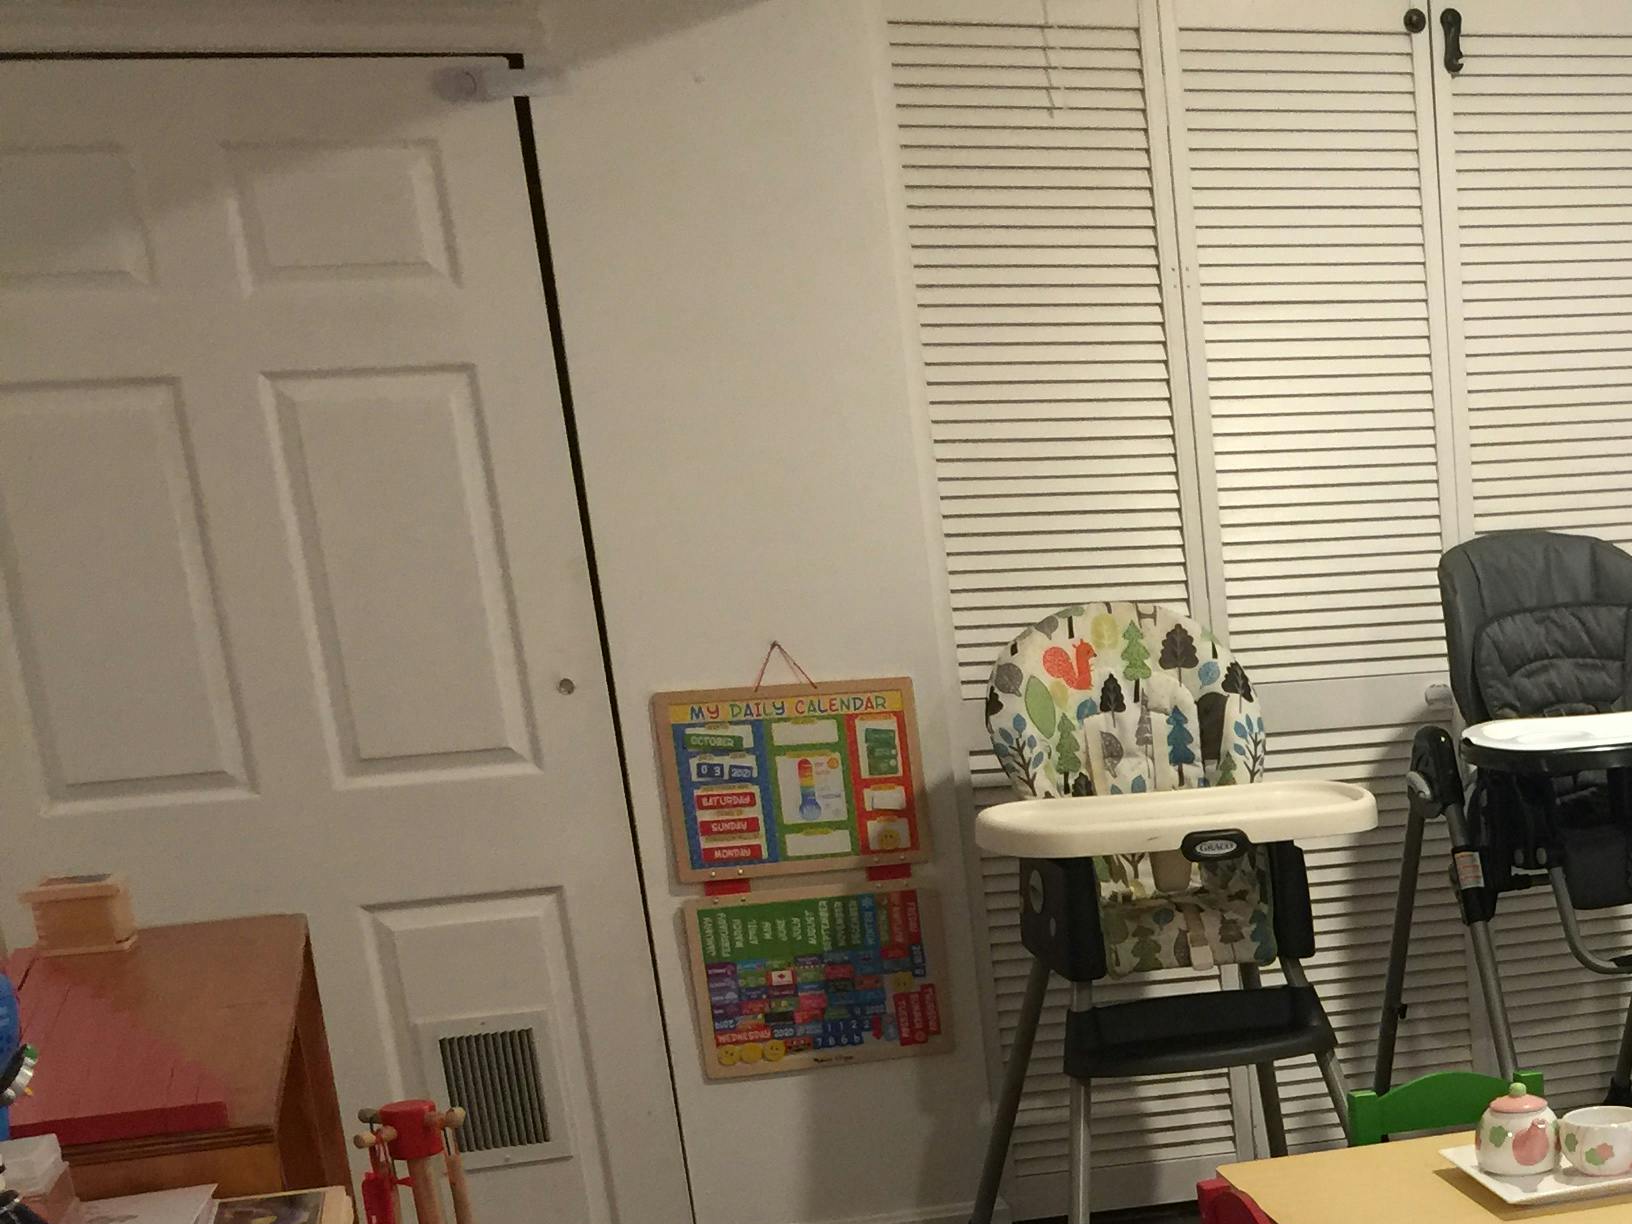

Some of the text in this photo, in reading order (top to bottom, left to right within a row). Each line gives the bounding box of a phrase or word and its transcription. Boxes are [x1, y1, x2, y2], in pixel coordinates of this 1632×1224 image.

[690, 695, 887, 720] MY DAILY CALENDAR
[690, 735, 735, 747] OCTOBER
[702, 795, 751, 807] SATURDAY
[711, 821, 748, 832] SUNDAY
[714, 847, 751, 859] MONDAY
